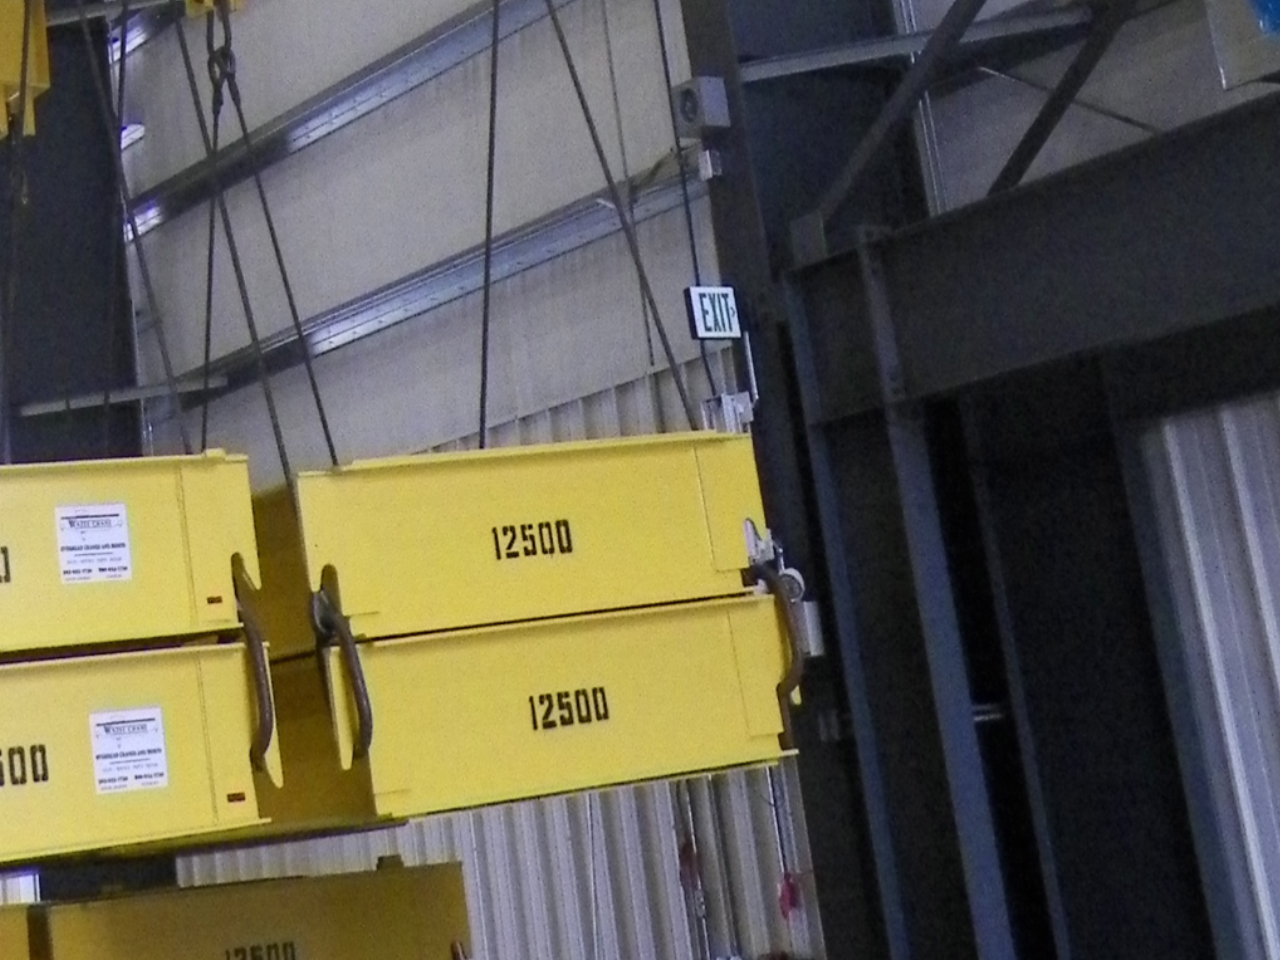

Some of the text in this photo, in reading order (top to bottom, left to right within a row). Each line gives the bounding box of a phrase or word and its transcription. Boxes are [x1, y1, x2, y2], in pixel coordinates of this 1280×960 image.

[698, 292, 733, 332] EXIT
[491, 519, 573, 560] 12500
[528, 686, 609, 731] 12500
